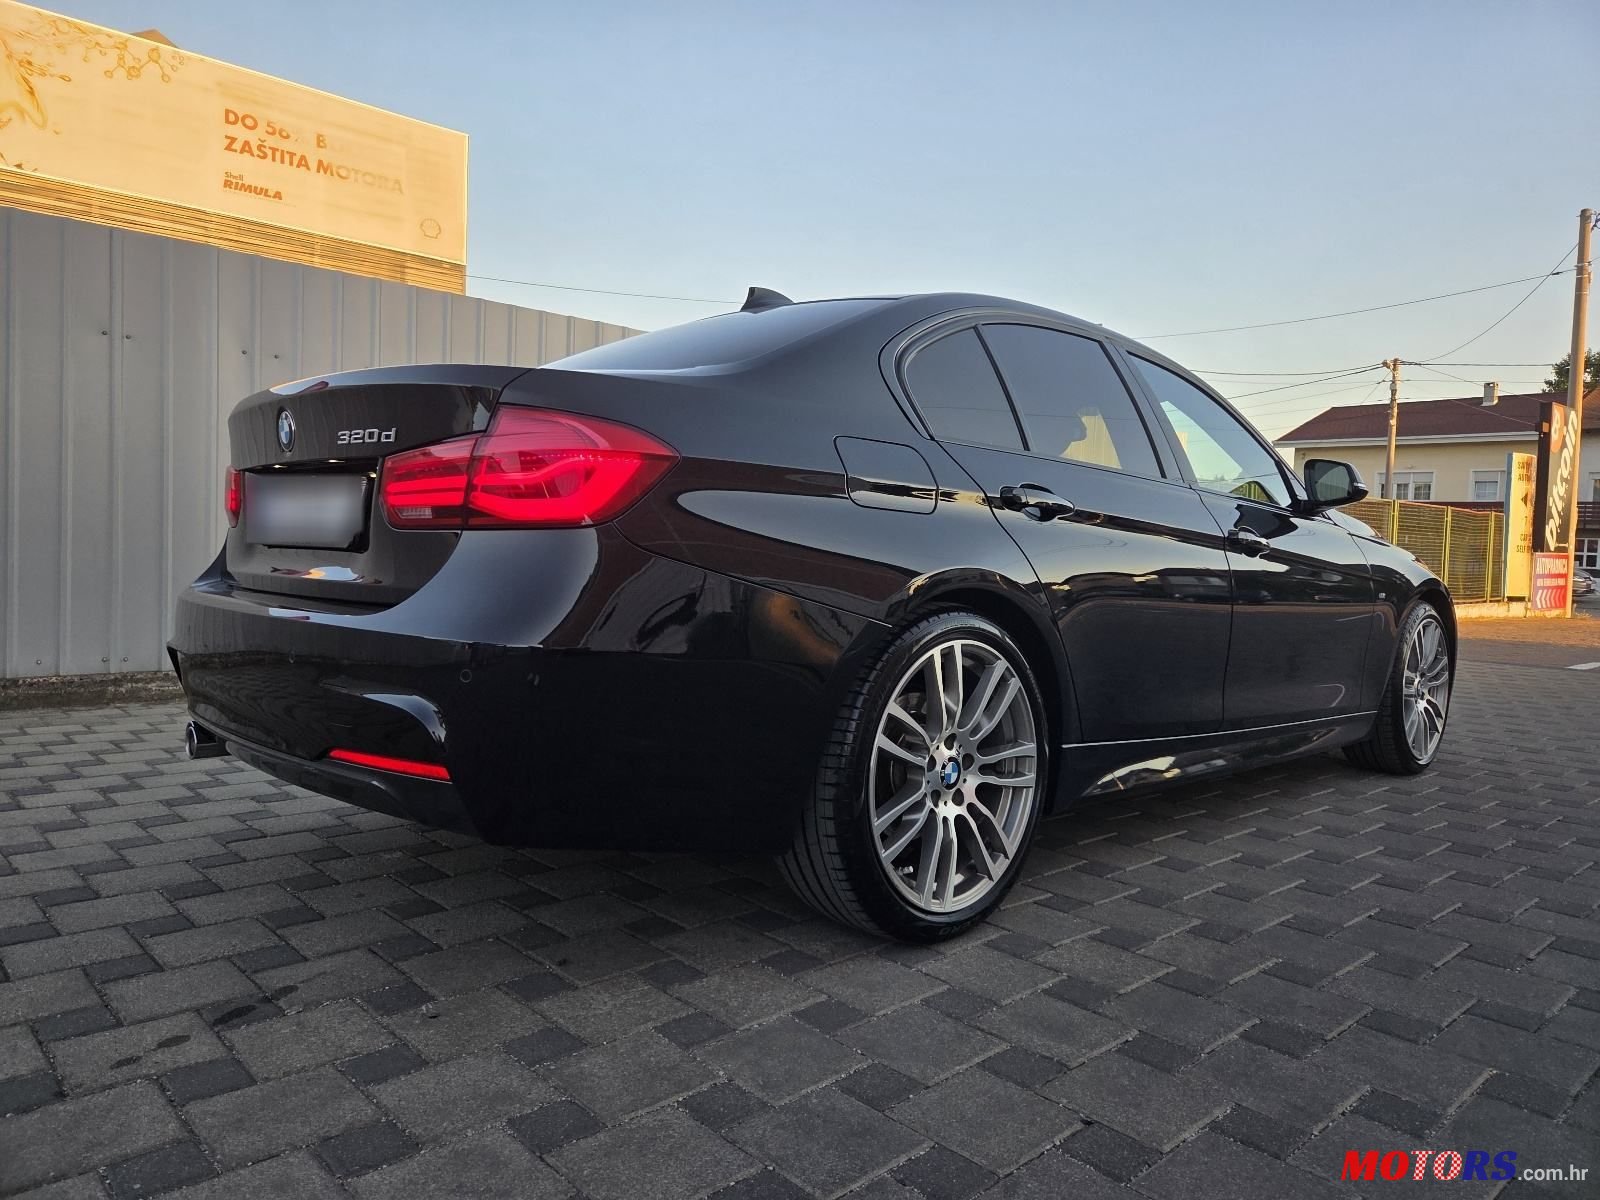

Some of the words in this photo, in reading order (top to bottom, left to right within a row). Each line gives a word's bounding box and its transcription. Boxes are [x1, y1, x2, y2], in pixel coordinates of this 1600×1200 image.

[224, 108, 259, 131] DO
[224, 134, 311, 172] ZAŠTITA
[224, 171, 244, 181] Shell
[223, 178, 283, 200] RIMULA
[337, 427, 397, 444] 320d
